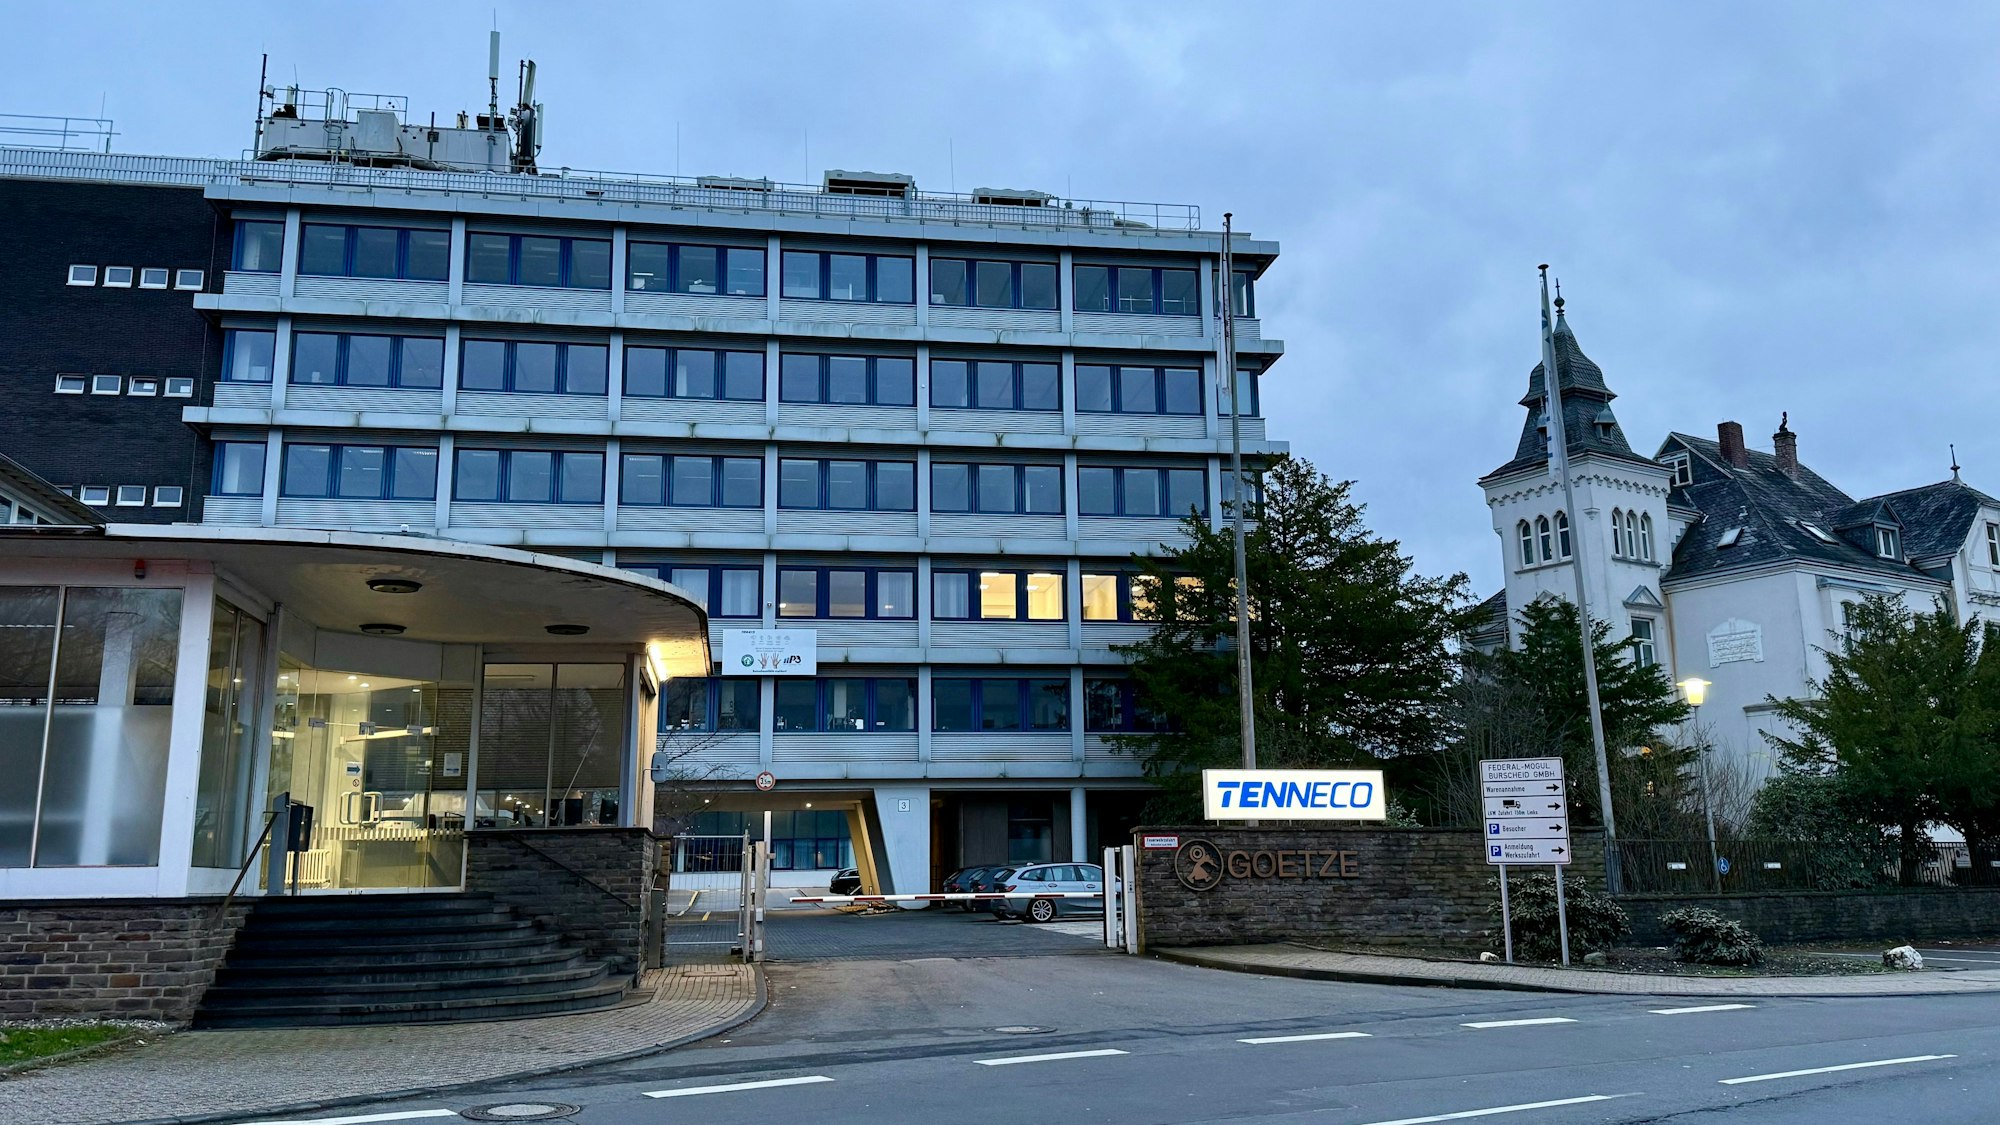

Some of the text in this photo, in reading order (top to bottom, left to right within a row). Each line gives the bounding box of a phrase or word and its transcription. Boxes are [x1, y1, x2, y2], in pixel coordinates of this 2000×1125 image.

[1488, 762, 1550, 771] FEDERAL-MOGUL
[1486, 785, 1525, 793] Warenannahme
[1217, 781, 1373, 808] TENNECO
[901, 802, 907, 810] 3
[1504, 843, 1533, 851] Anmeldung
[1227, 850, 1360, 879] GOETZE
